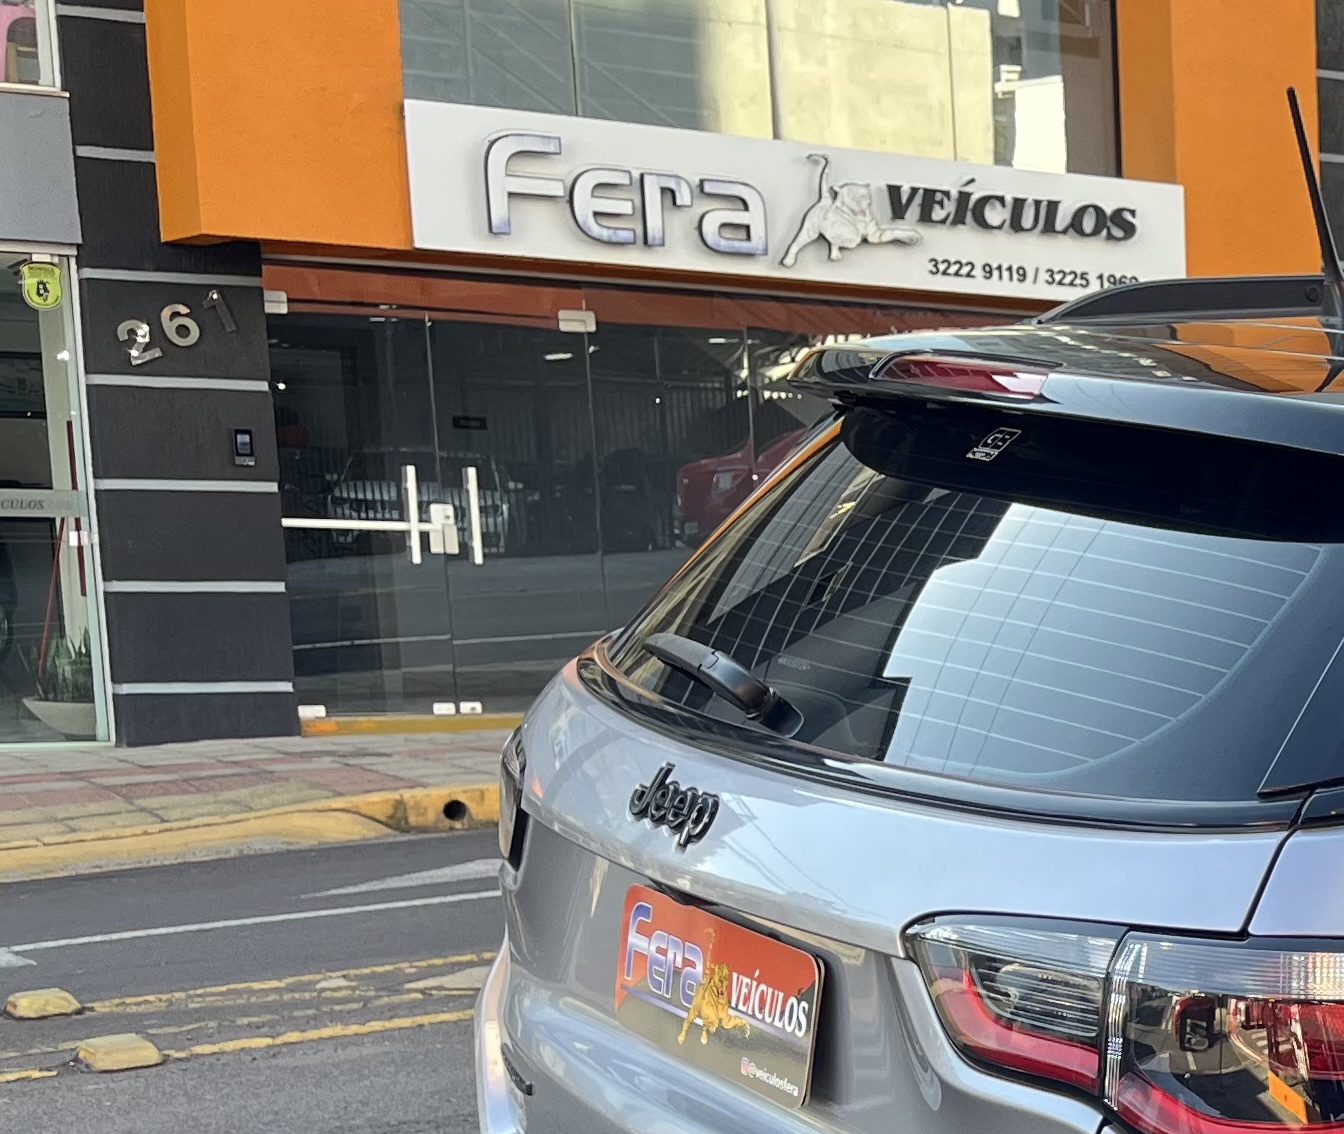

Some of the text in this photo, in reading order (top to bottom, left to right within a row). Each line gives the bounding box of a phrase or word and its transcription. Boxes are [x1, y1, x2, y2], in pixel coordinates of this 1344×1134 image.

[484, 132, 1139, 256] Fera VEÍCULOS
[928, 258, 976, 278] 3222
[982, 263, 1027, 283] 9119
[1045, 268, 1089, 288] 3225
[117, 289, 236, 366] 261
[628, 761, 719, 852] Jeep
[624, 902, 809, 1038] Fera VEÍCULOS
[749, 1062, 799, 1097] @veiculosfera
